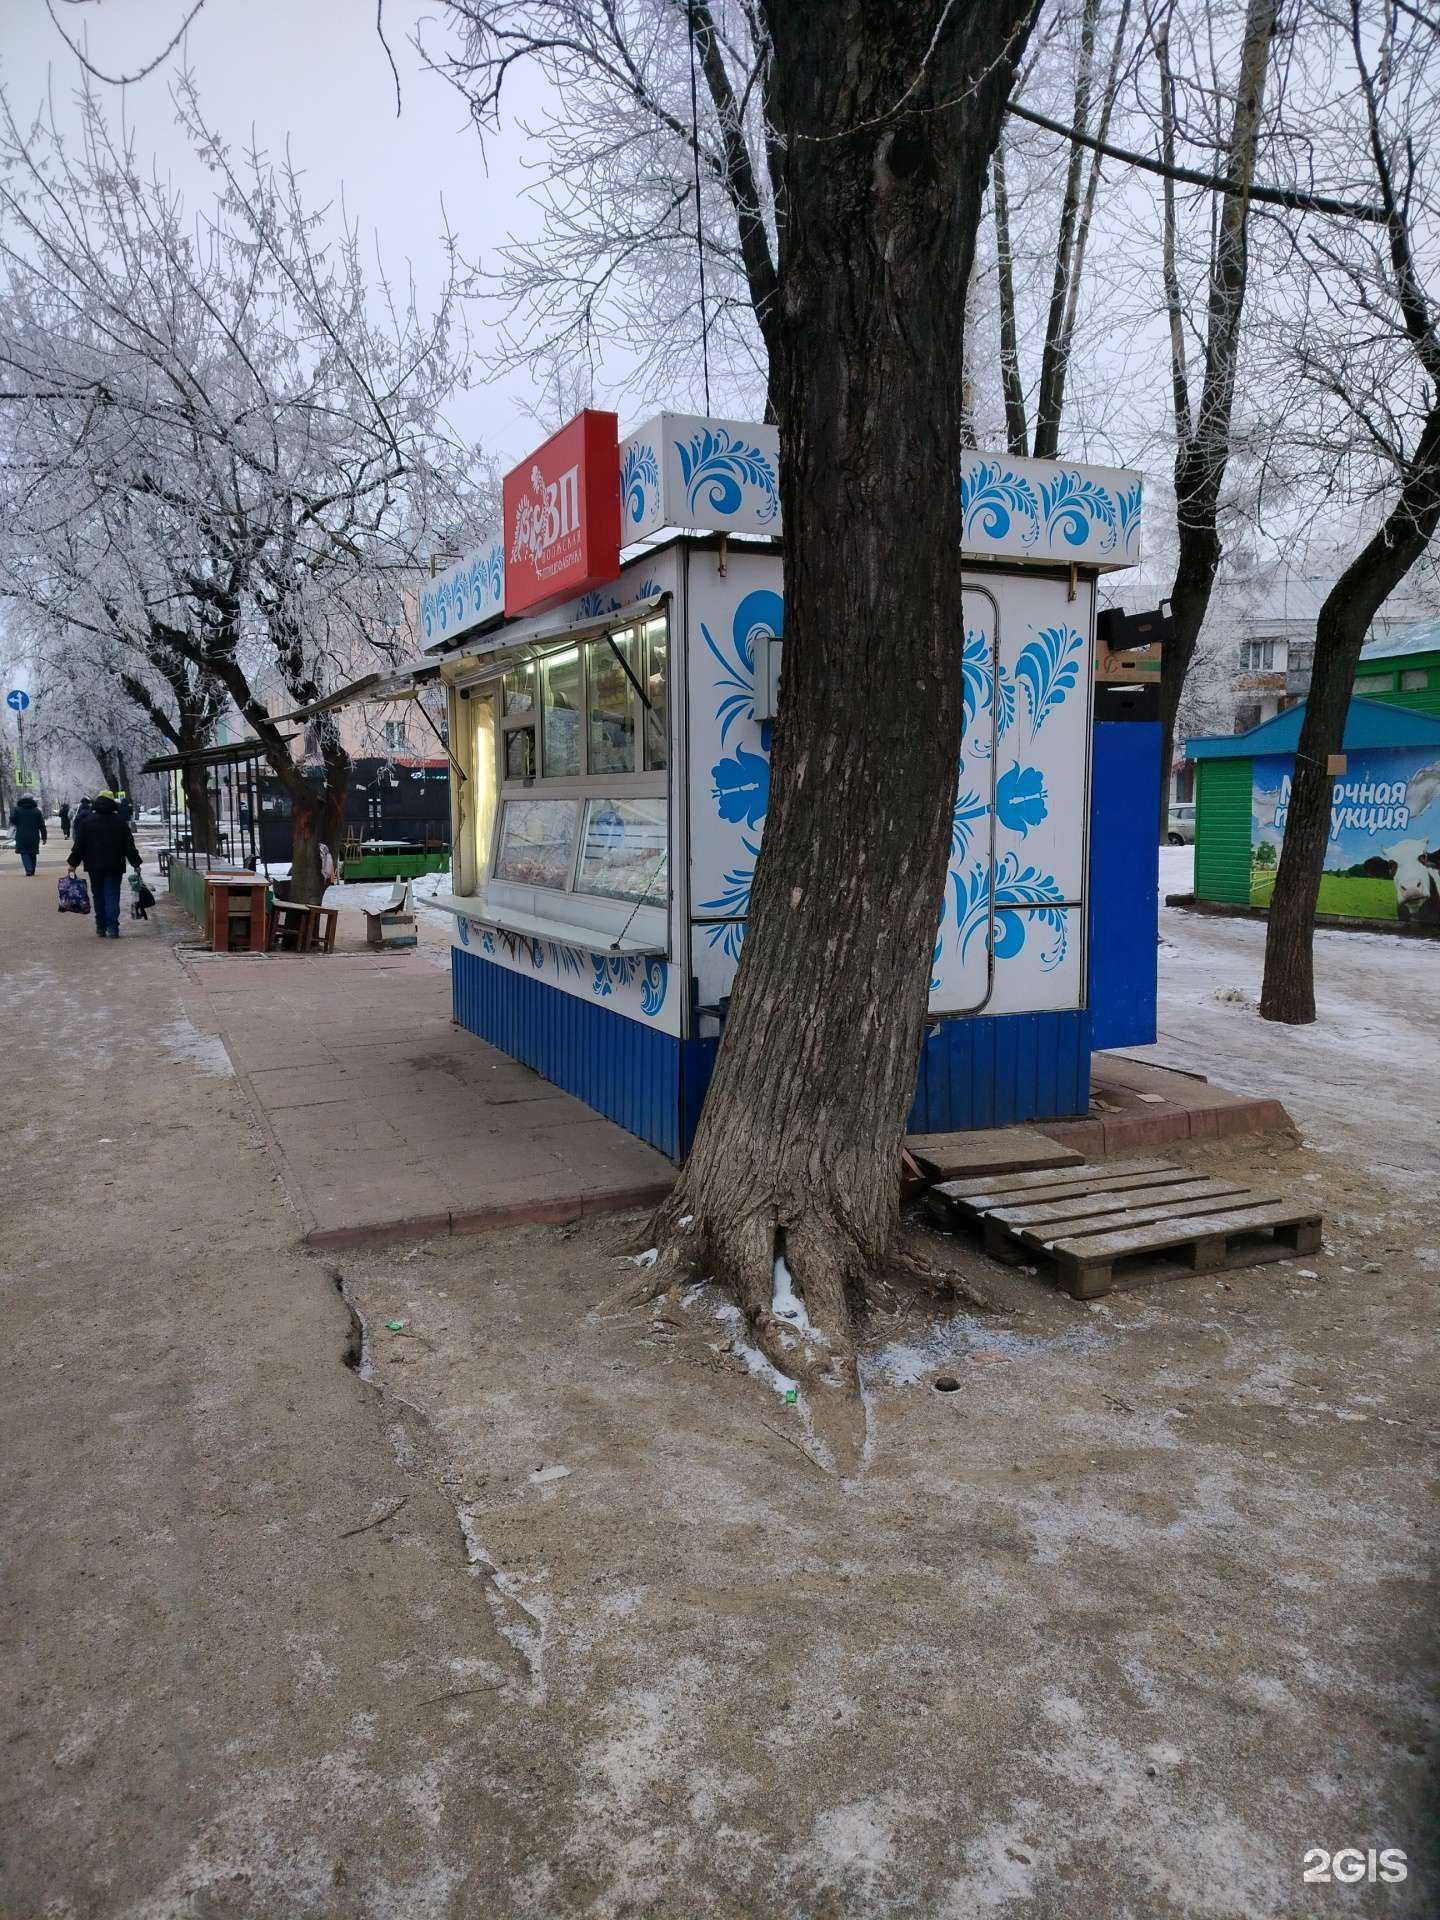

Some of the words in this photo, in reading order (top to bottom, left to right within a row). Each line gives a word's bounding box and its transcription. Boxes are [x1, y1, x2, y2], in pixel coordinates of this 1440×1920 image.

[541, 548, 582, 579] ЦЕФАБРИКА
[1279, 775, 1407, 805] Мочная
[1274, 807, 1410, 840] пукция
